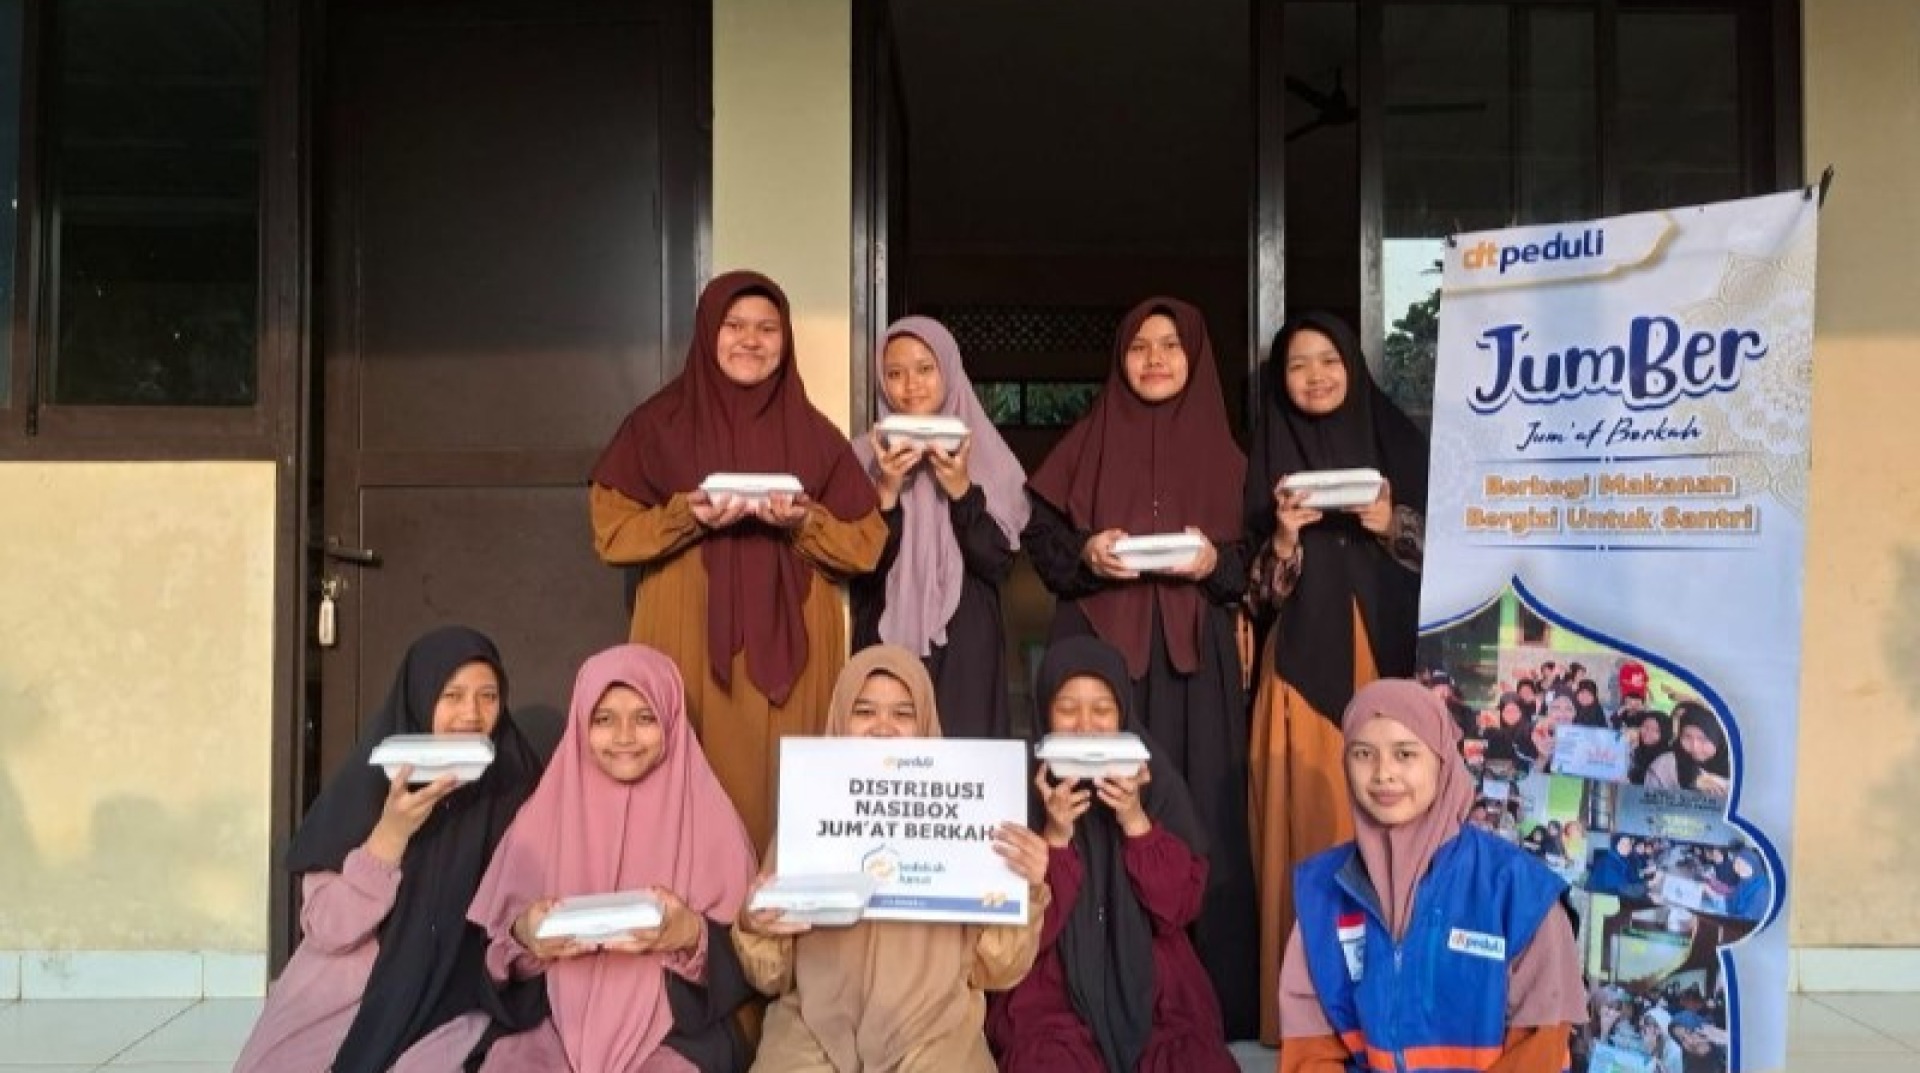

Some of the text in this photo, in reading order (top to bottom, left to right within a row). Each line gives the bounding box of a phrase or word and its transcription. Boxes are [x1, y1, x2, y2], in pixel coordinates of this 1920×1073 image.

[1463, 230, 1604, 272] dtpeduli
[1468, 316, 1768, 414] JumBer
[1516, 419, 1604, 451] Jum'at
[1484, 472, 1734, 498] Berbagi Makanan
[1465, 504, 1752, 532] Bergizi Untuk Santri
[849, 778, 985, 799] DISTRIBUSI
[855, 800, 959, 819] NASIBOX
[816, 820, 995, 841] JUM'AT BERKAH
